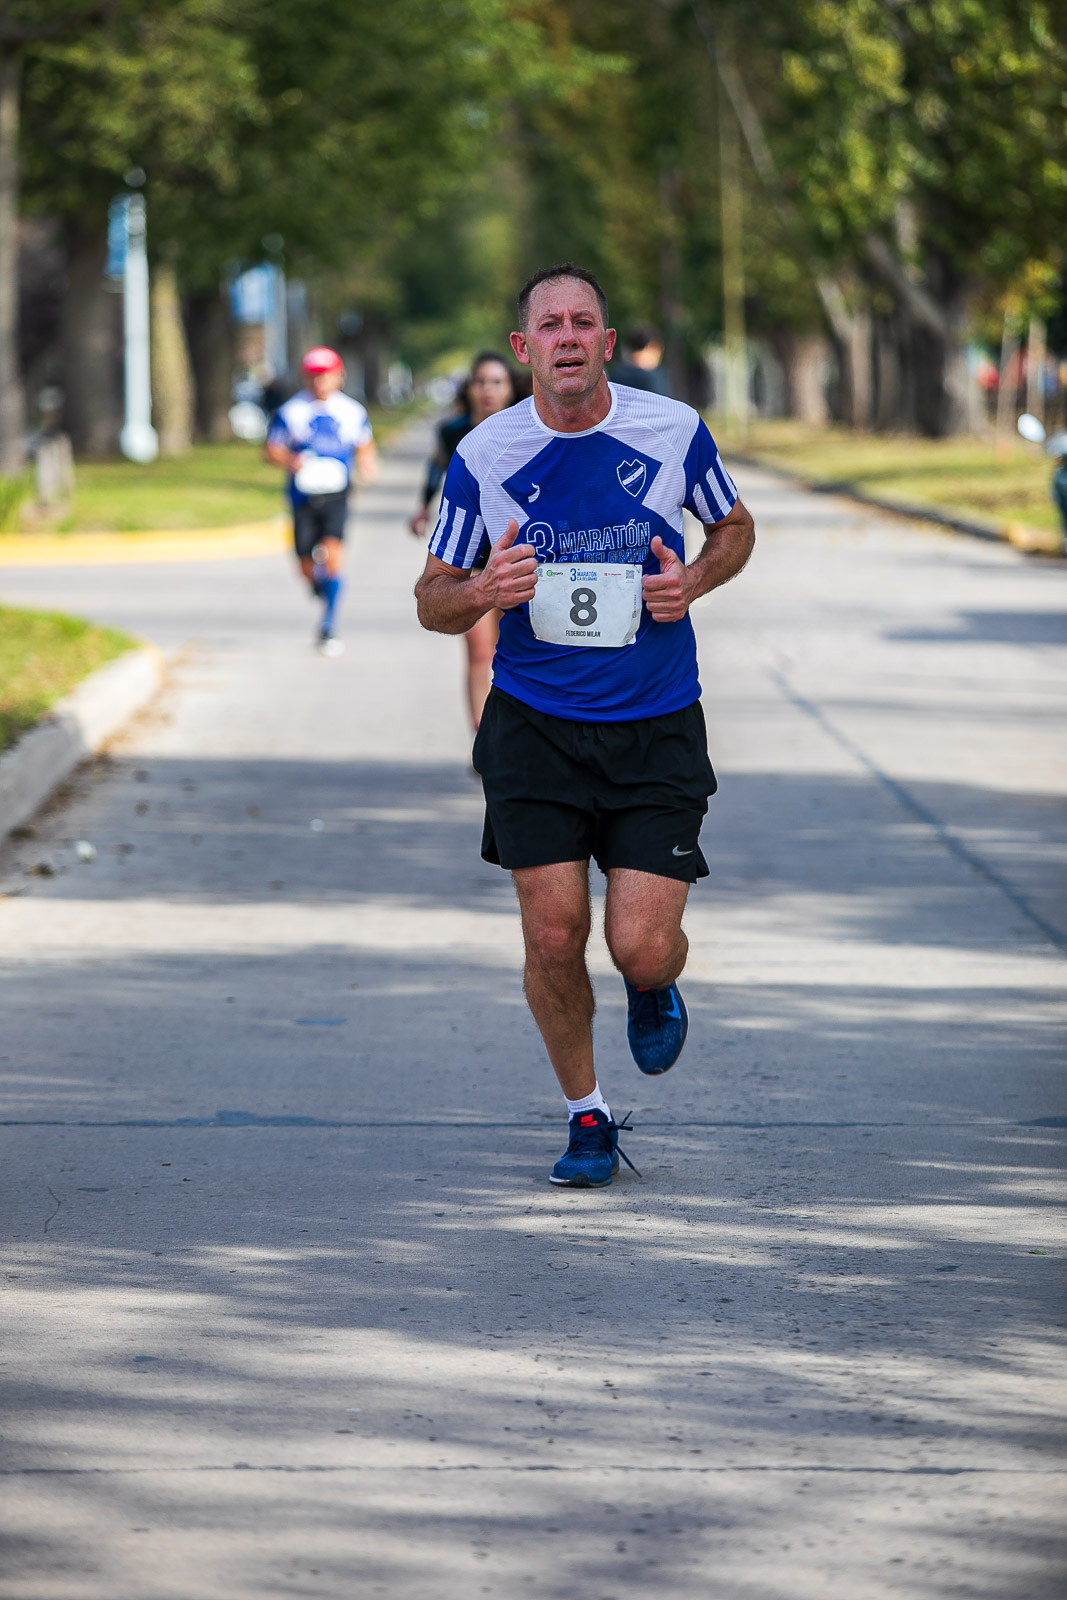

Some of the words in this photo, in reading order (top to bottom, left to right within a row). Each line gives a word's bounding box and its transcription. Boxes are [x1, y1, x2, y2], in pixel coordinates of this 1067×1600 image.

[559, 519, 650, 555] MARATÓN
[570, 567, 577, 582] 3
[570, 588, 598, 627] 8
[566, 630, 587, 638] FEDERICO
